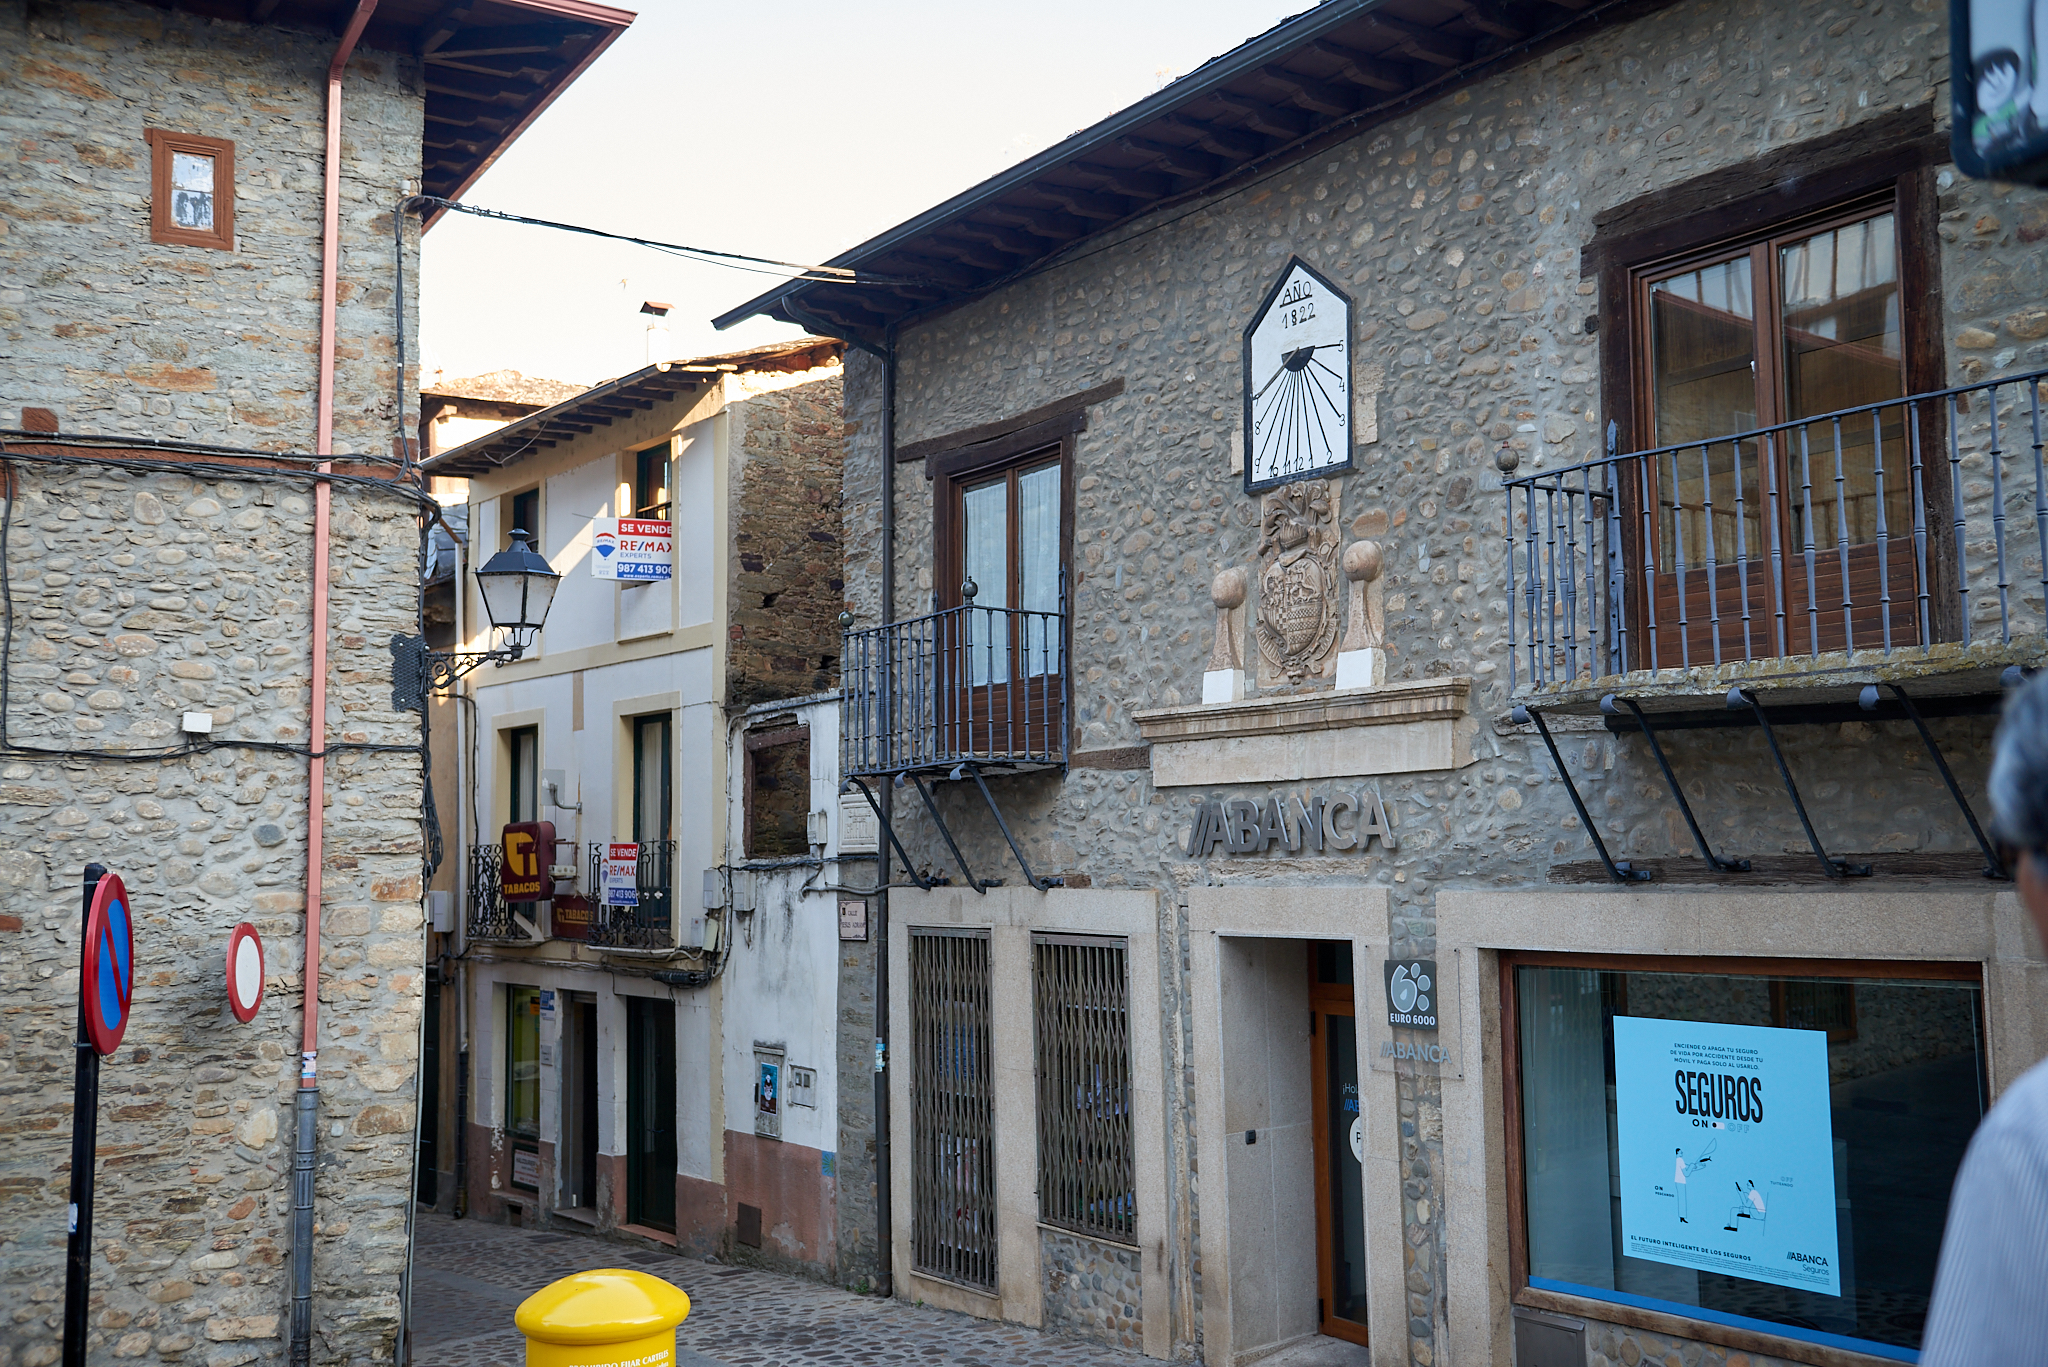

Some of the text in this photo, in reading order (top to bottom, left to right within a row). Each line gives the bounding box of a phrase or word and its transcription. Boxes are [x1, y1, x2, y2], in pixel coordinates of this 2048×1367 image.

[1282, 280, 1312, 305] AÑO
[1281, 303, 1316, 329] 1822
[1338, 339, 1344, 352] 5
[1338, 378, 1345, 392] 4
[1338, 413, 1346, 427] 3
[1254, 420, 1261, 435] 8
[1293, 456, 1304, 472] 12
[1308, 455, 1314, 468] 1
[1326, 450, 1334, 464] 2
[1254, 457, 1260, 474] 9
[1268, 464, 1279, 478] 10
[1283, 459, 1292, 474] 11
[621, 523, 672, 534] SE VENDE
[617, 563, 636, 573] 987
[637, 564, 654, 574] 413
[610, 848, 637, 857] SE VENDE
[609, 865, 636, 876] RE/MAX
[503, 881, 541, 894] TABACOS
[616, 889, 624, 898] 413
[625, 890, 636, 899] 906
[564, 909, 594, 921] TABACOS
[1389, 1012, 1436, 1026] EURO 6000
[1674, 1042, 1701, 1050] ENCIENDE
[1673, 1056, 1691, 1064] MÓVIL
[1704, 1053, 1735, 1061] ACCIDENTE
[1675, 1069, 1763, 1123] SEGUROS
[1692, 1118, 1750, 1133] ON OFF
[1638, 1236, 1661, 1245] FUTURO
[1662, 1240, 1700, 1252] INTELIGENTE
[1723, 1251, 1752, 1261] SEGUROS
[1802, 1263, 1830, 1276] Seguros
[642, 1349, 669, 1365] CARTELES
